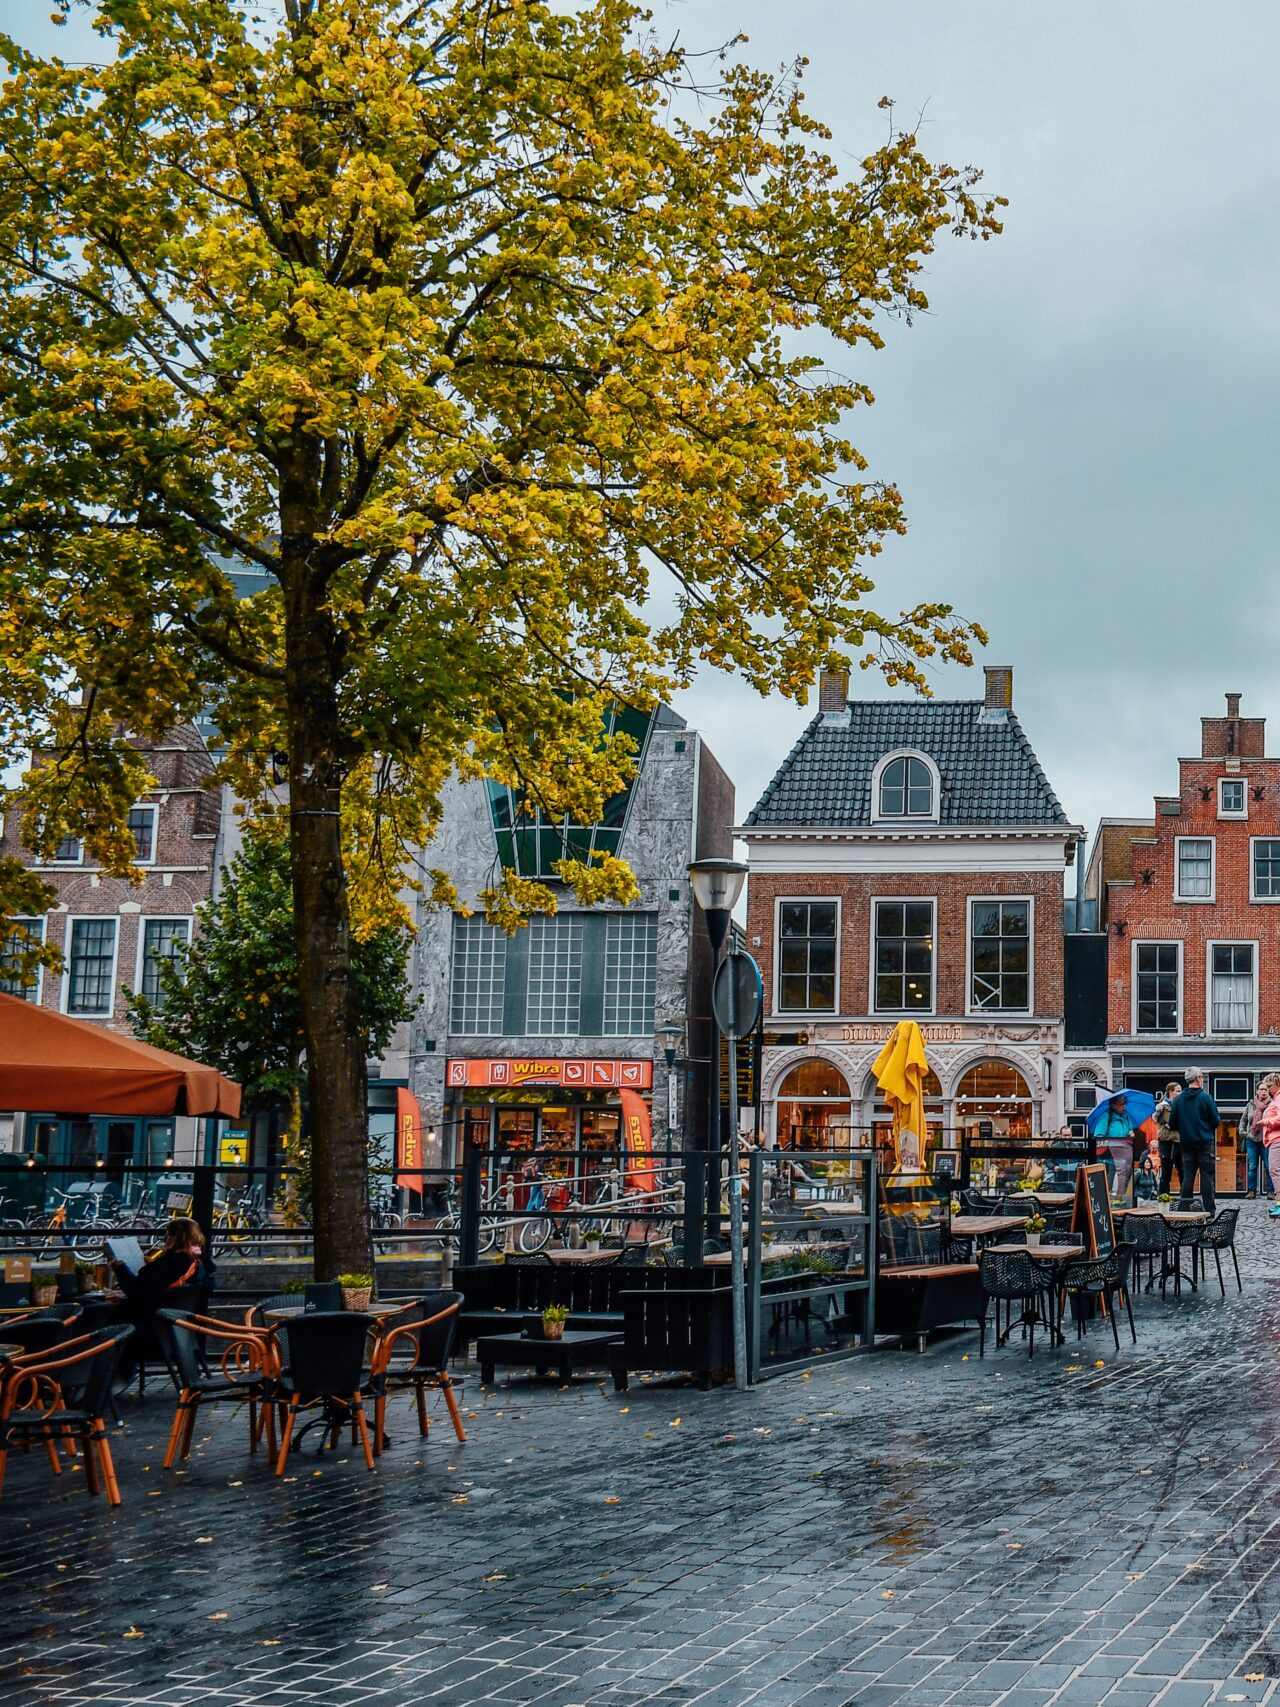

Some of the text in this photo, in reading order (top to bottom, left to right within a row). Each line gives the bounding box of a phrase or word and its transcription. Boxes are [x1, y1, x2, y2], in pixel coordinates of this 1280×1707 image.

[841, 1027, 881, 1041] DILLE
[920, 1027, 962, 1041] MILLE
[513, 1060, 560, 1074] Wibra
